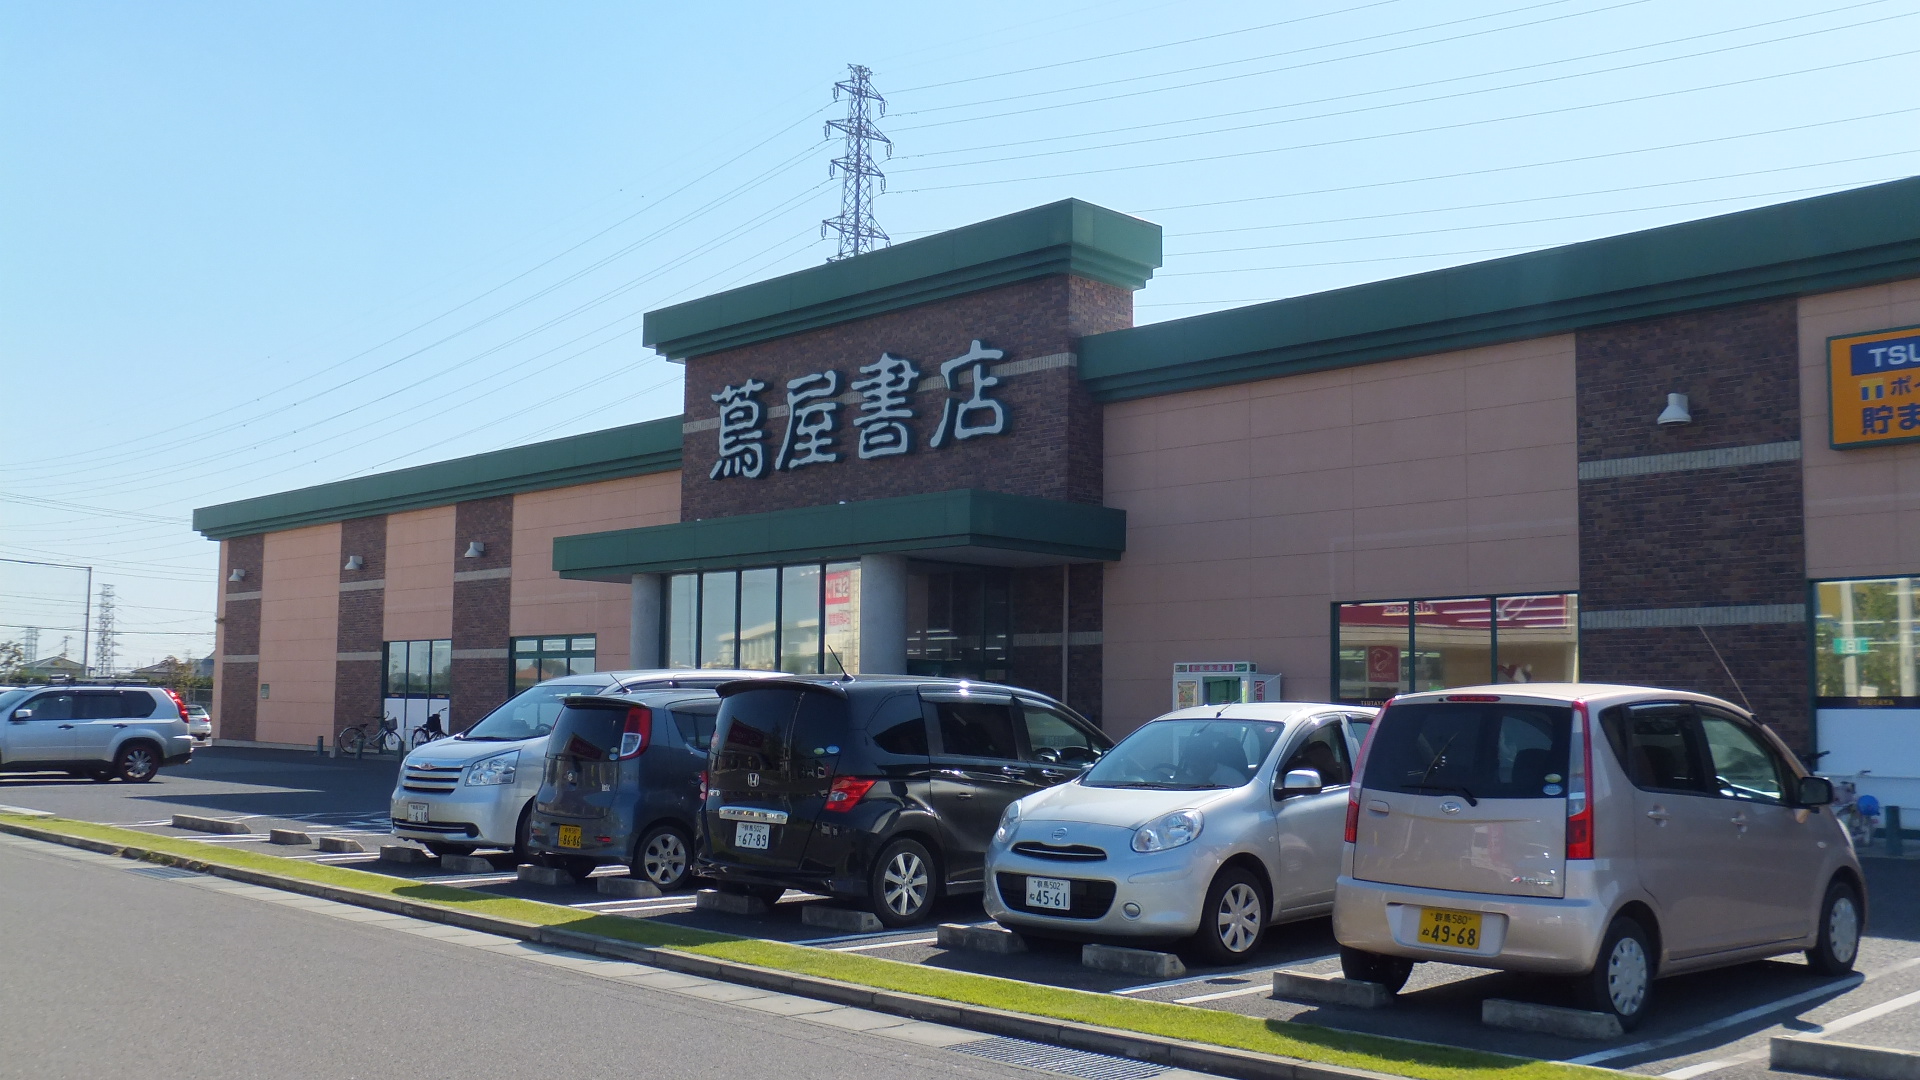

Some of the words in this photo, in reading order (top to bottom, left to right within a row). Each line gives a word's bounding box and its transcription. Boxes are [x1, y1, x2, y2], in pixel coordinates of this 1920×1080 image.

[709, 339, 1004, 480] 蔦屋書店
[1891, 375, 1920, 396] ポ
